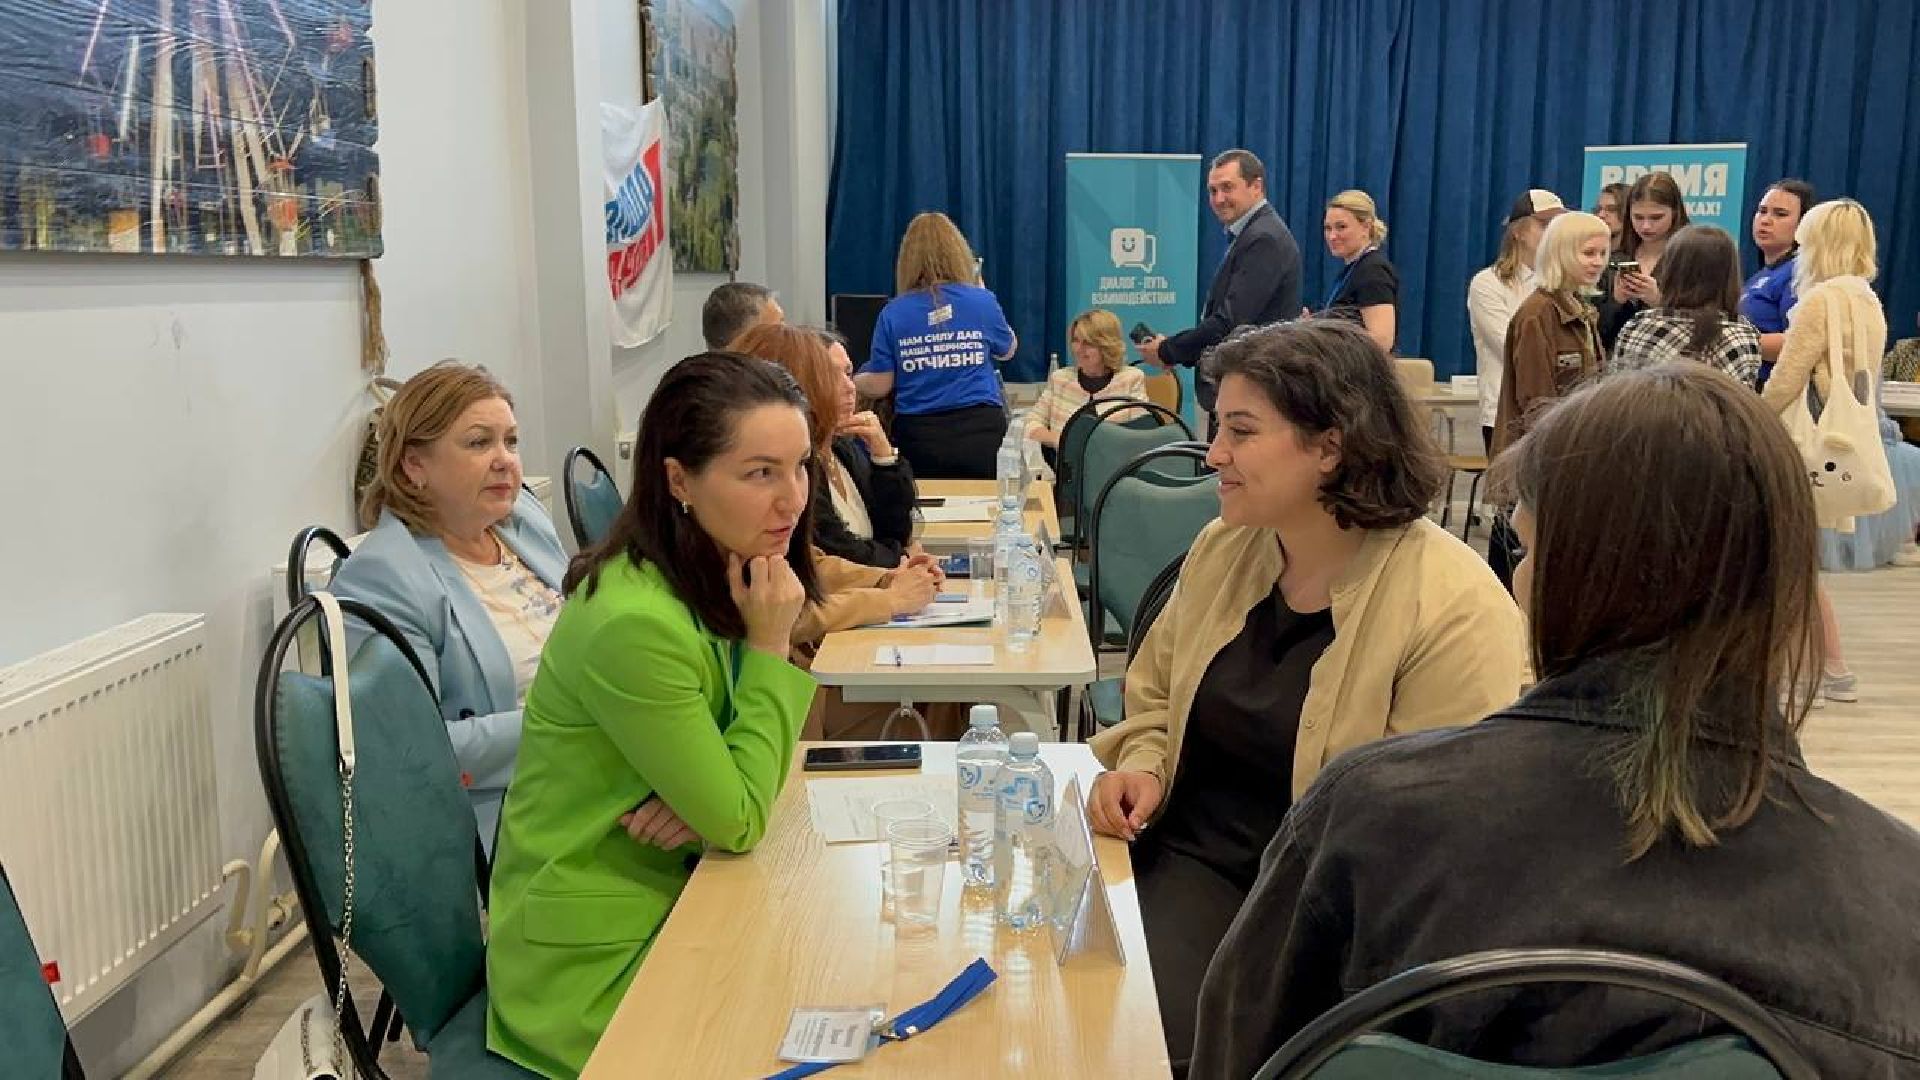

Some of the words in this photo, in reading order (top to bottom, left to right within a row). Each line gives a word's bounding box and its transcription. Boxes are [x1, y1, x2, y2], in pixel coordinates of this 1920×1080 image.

[1600, 163, 1728, 197] ВРМЯ
[899, 335, 922, 346] НАМ
[924, 332, 955, 343] СИЛУ
[899, 347, 931, 357] НАША
[933, 341, 984, 352] ВЕРНОСТЬ
[902, 351, 985, 373] ОТЧИЗНЕ
